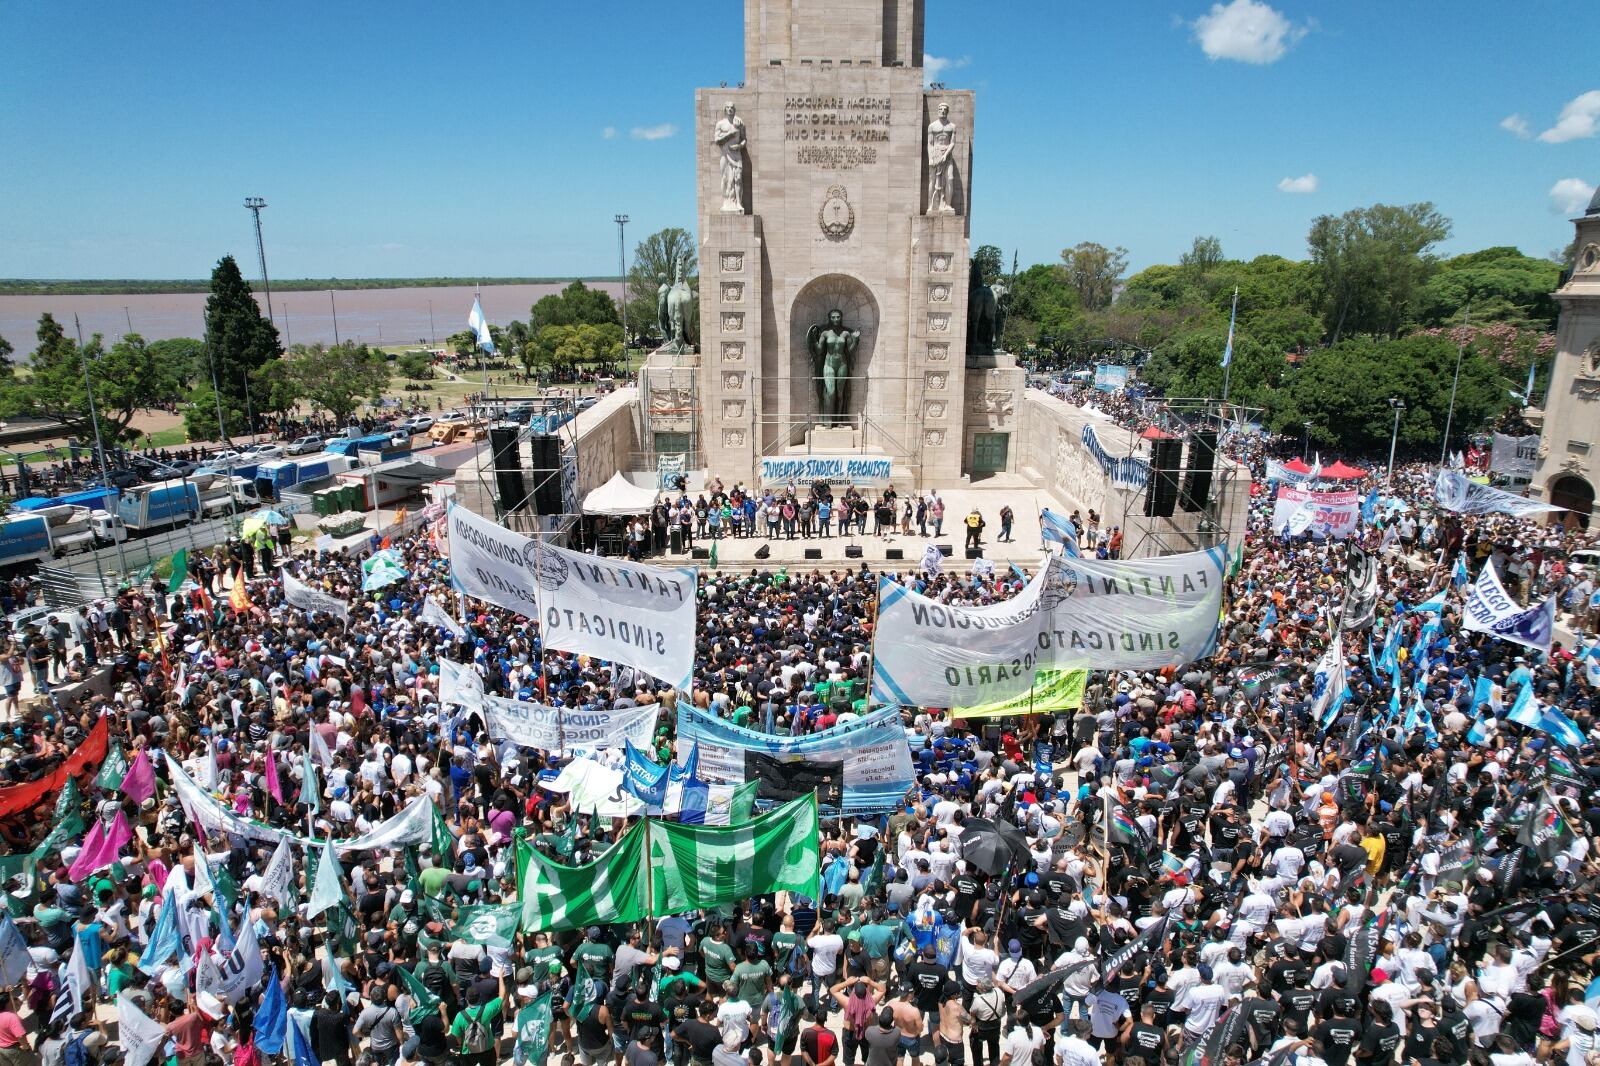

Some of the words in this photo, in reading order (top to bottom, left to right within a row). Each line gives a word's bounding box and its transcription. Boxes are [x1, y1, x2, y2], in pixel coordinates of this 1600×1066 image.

[785, 114, 820, 125] DIGNO
[822, 114, 836, 125] DE
[838, 114, 891, 126] LLAMARME
[785, 129, 808, 141] HIJO
[812, 129, 826, 141] DE
[830, 129, 845, 141] LA
[850, 130, 889, 142] PATRIA
[763, 460, 806, 478] JUVENTUD
[806, 459, 844, 476] SINDICAL
[846, 460, 891, 478] PERONISTA
[797, 478, 827, 486] Seccil
[827, 478, 851, 486] Rosario
[1480, 569, 1511, 611] DIEGO
[1349, 948, 1358, 970] Rosario
